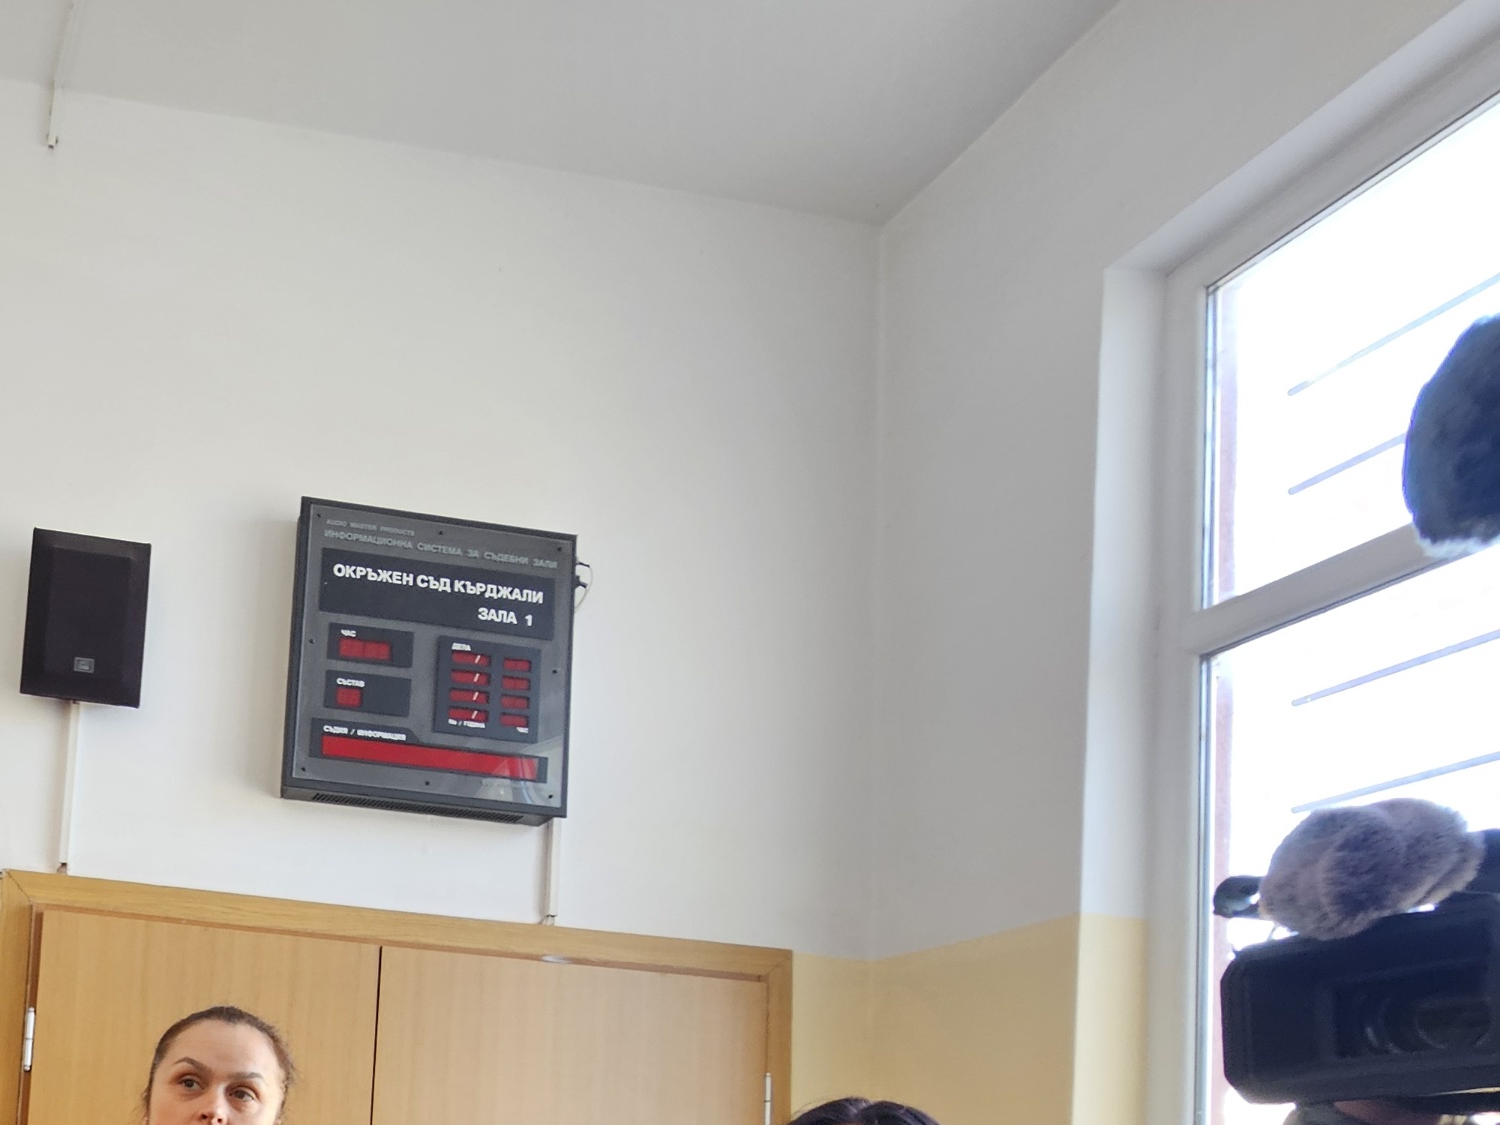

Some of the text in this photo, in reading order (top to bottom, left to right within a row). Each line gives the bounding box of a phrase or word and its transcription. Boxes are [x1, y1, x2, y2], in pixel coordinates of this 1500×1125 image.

[324, 529, 558, 569] ИНФОРМАЦИОННА СИСТЕМА ЗА СЪДЕБНИ ЗАЛИ
[333, 563, 544, 604] ОКРЪЖЕН СЪД КЪРДЖАЛИ
[478, 607, 533, 627] ЗАЛА 1
